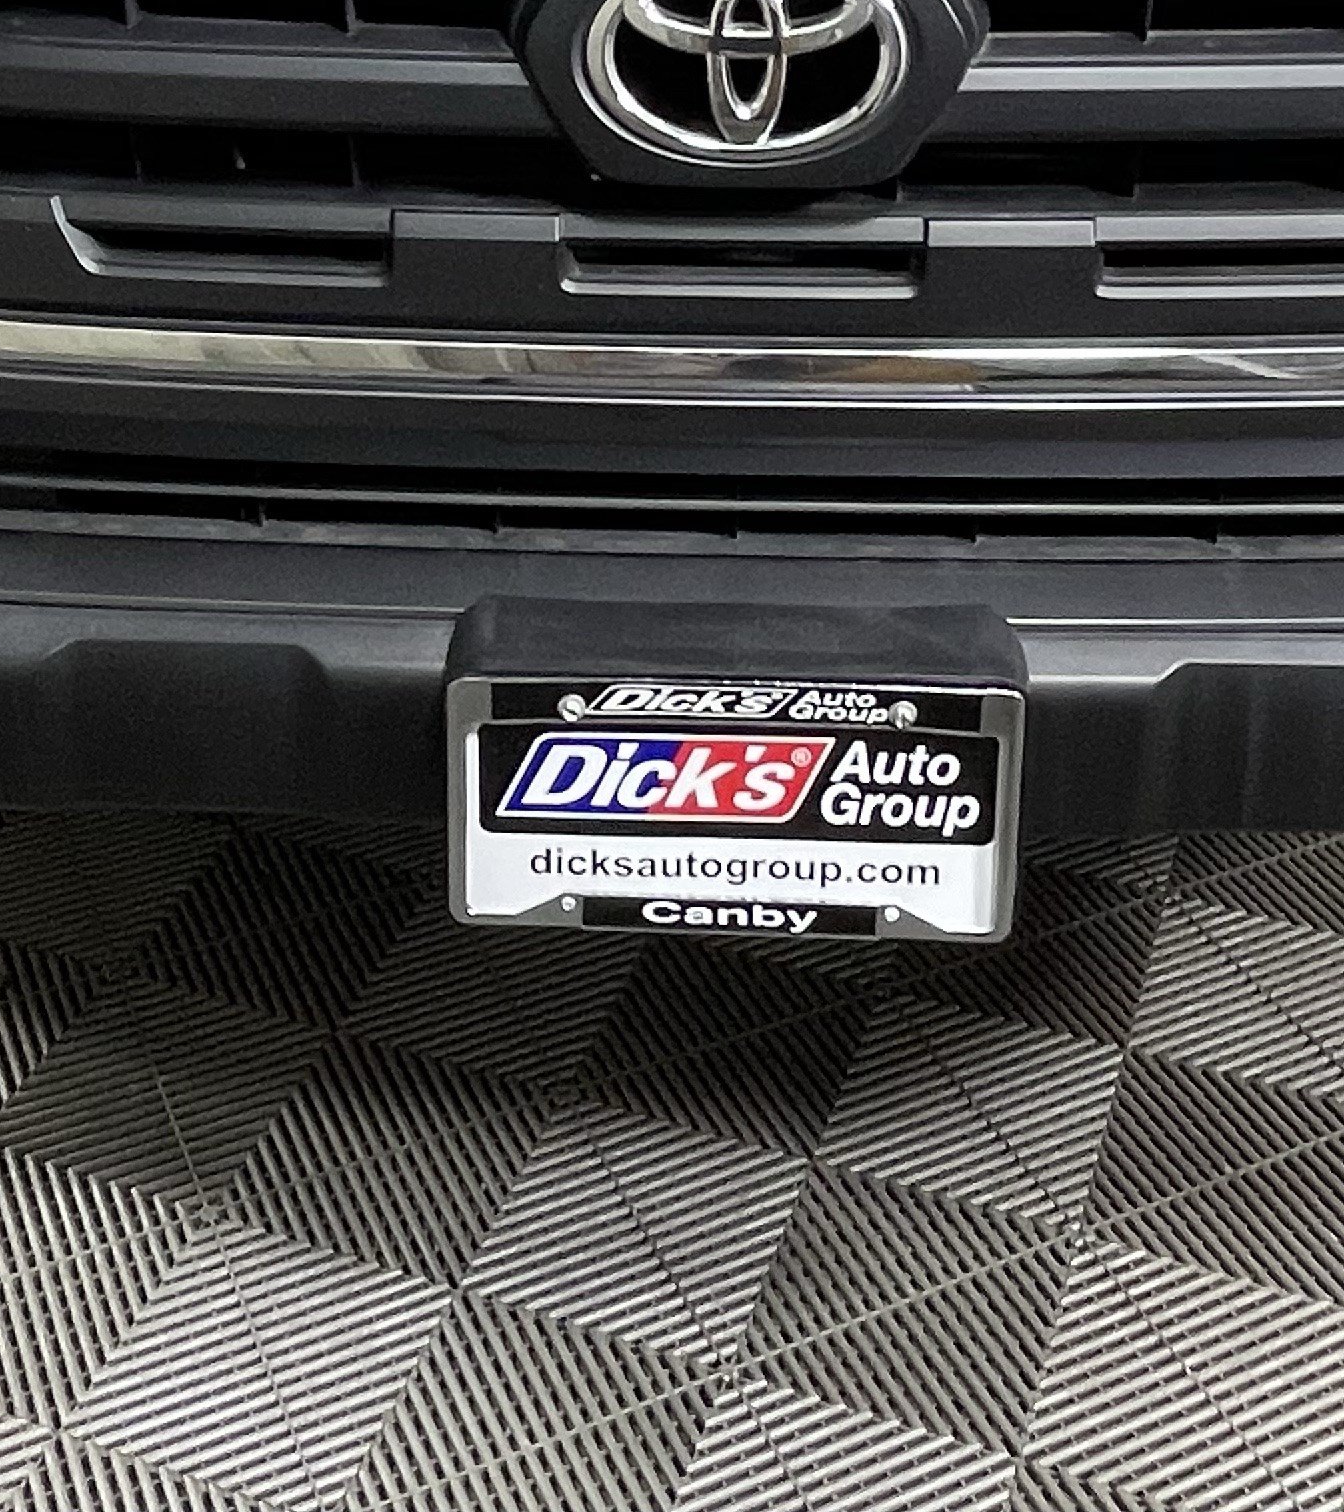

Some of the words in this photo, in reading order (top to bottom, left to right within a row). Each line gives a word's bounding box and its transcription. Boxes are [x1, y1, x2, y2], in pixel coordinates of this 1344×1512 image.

[788, 705, 888, 724] Group
[801, 691, 877, 710] Auto
[831, 741, 960, 787] Auto
[820, 787, 980, 836] Group
[530, 849, 941, 886] dicksautogroup.com
[641, 901, 818, 932] Canby
